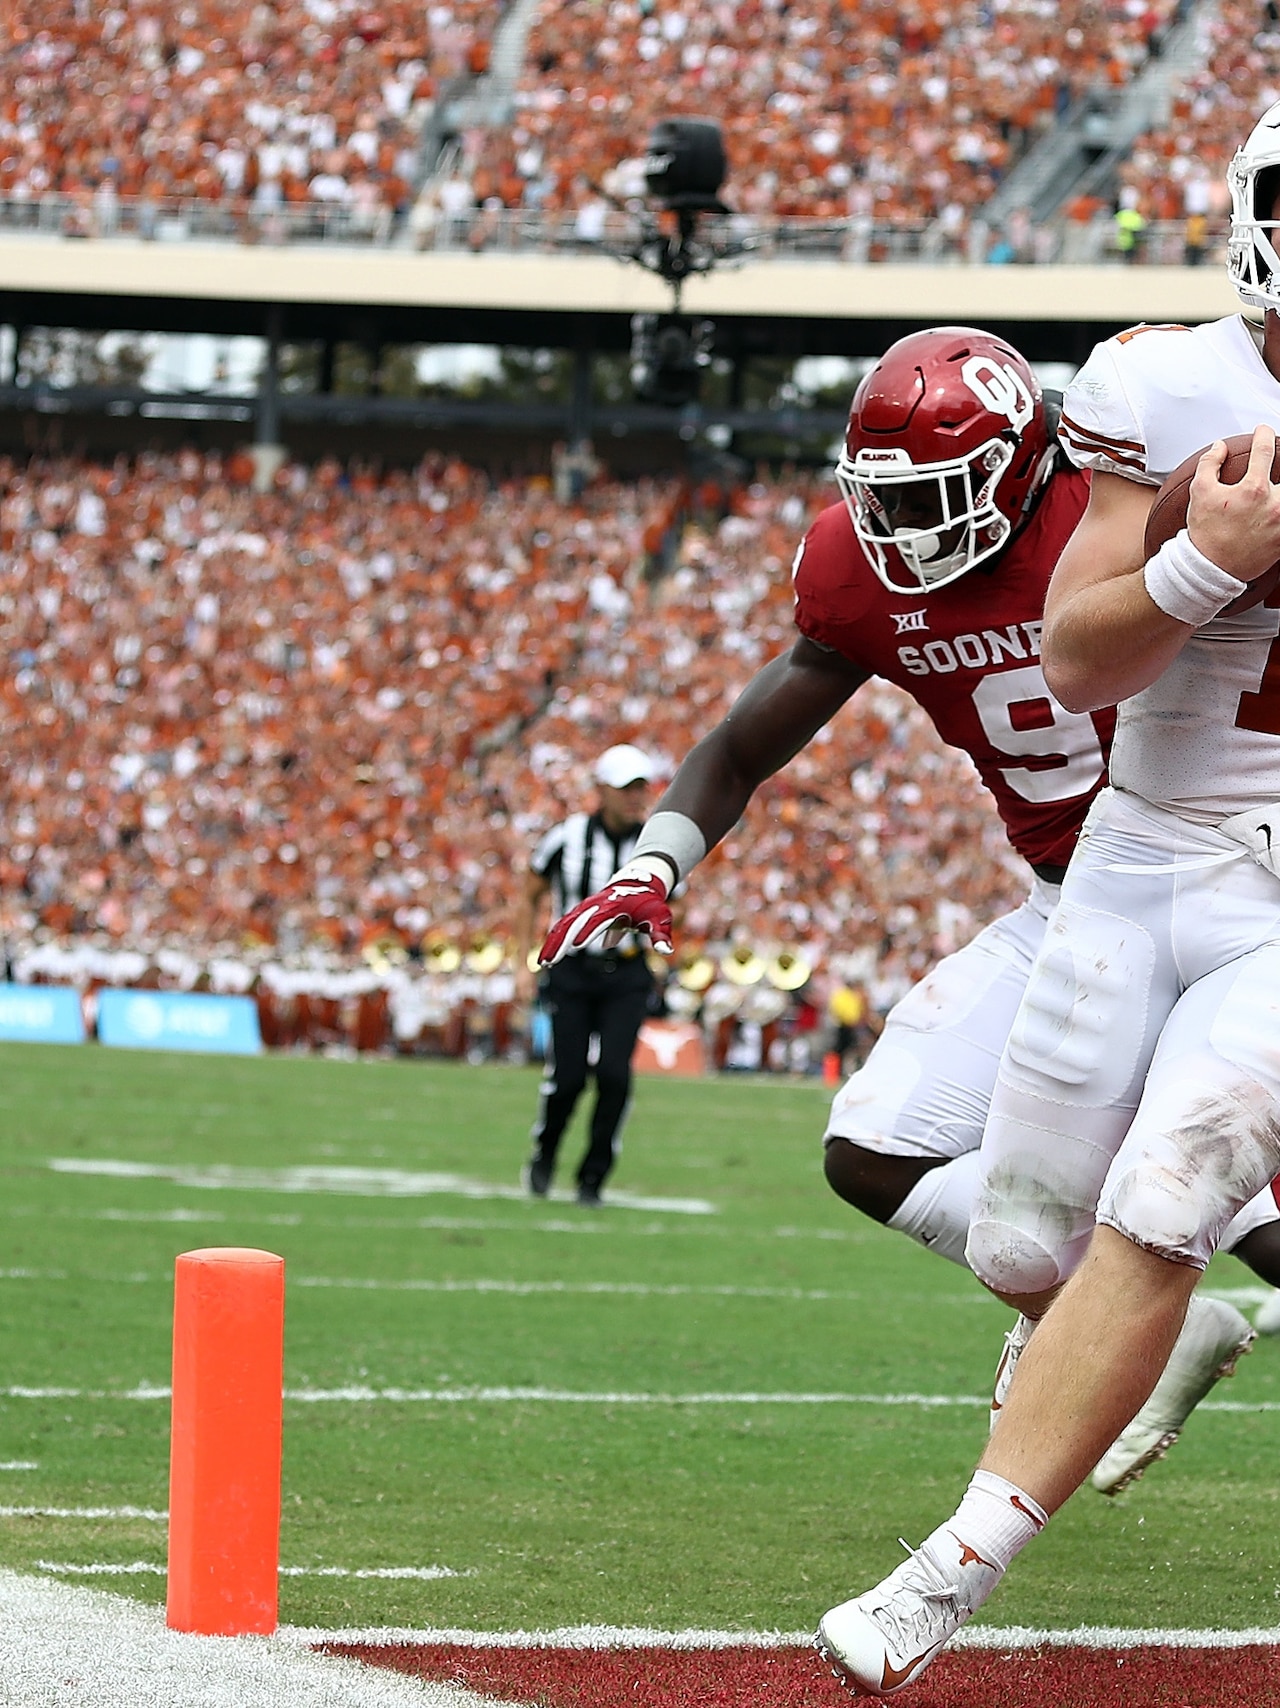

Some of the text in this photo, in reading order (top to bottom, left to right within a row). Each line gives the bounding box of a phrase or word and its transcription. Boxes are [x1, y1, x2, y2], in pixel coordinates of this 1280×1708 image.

[888, 608, 931, 635] XII
[896, 619, 1045, 676] SOONE
[971, 664, 1108, 804] 9
